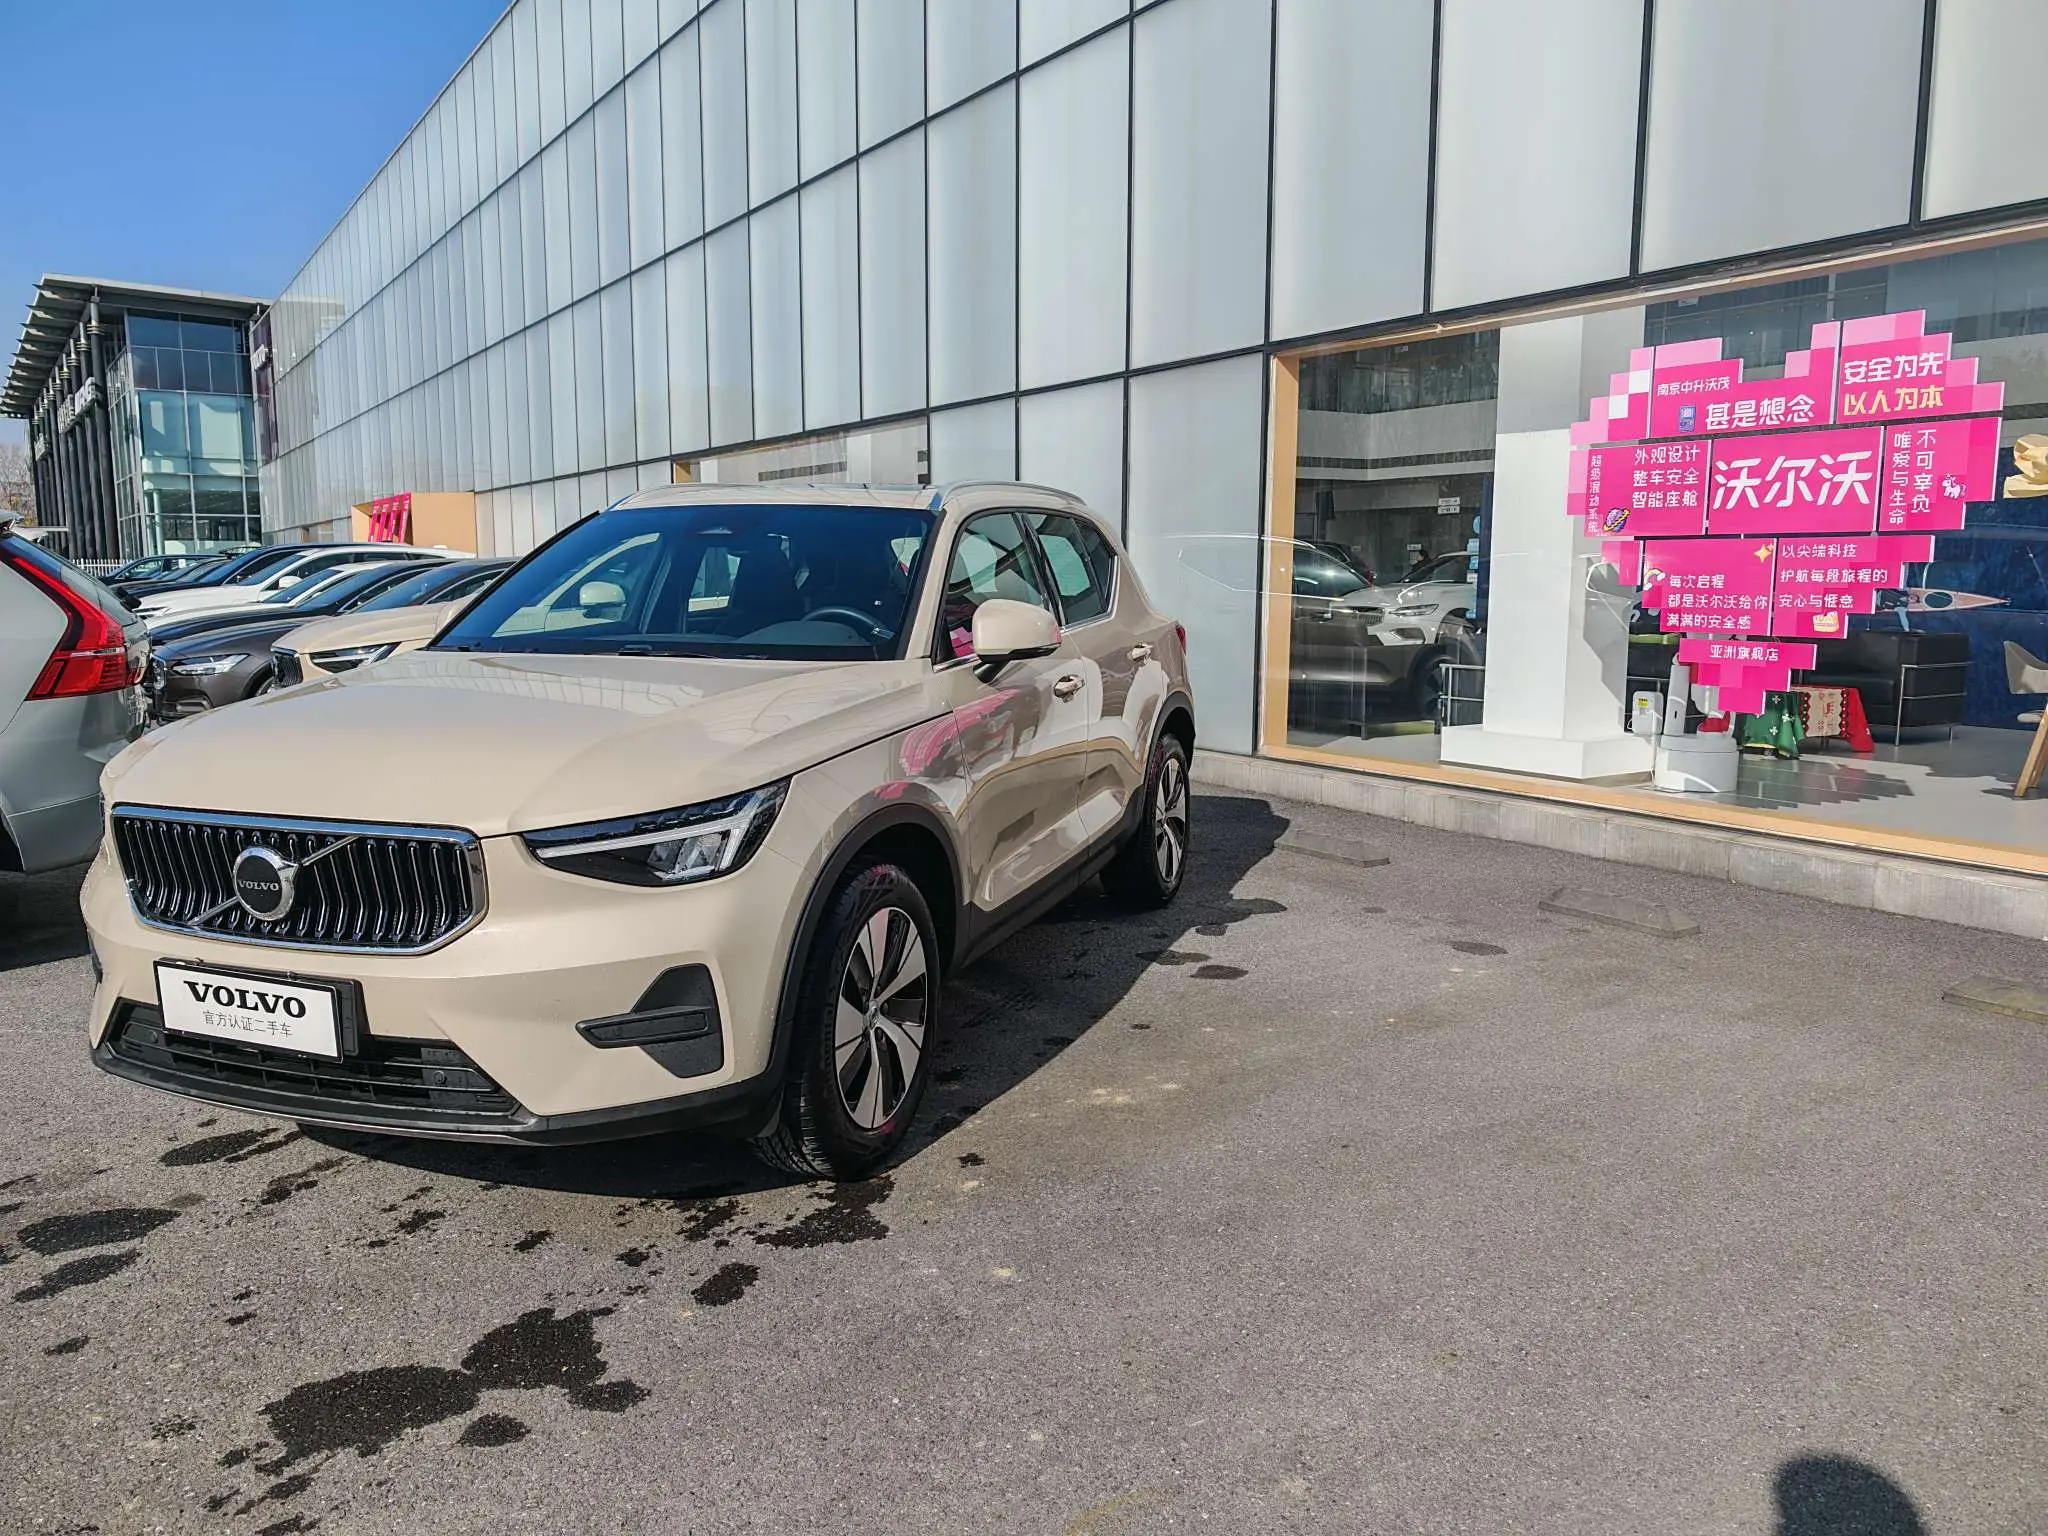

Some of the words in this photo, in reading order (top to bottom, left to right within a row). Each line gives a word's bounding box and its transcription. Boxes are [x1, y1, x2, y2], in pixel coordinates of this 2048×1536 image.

[1844, 352, 1944, 384] 安全为先
[1656, 376, 1731, 397] 南京中升沃茂
[1843, 385, 1944, 416] 以人为本
[1705, 394, 1815, 431] 甚是想念
[1634, 445, 1701, 465] 外观设计
[1633, 467, 1700, 487] 整车安全
[1713, 451, 1873, 510] 沃尔沃
[1888, 431, 1912, 525] 唯爱与生命
[1632, 489, 1698, 509] 智能座舱
[1782, 544, 1858, 559] 以尖端科技
[1669, 574, 1726, 589] 每次启程
[1780, 568, 1889, 584] 护航每段旅程的
[1667, 593, 1769, 610] 都是沃尔沃给你
[1666, 612, 1752, 630] 满满的安全感
[1709, 644, 1780, 662] 亚洲旗舰店
[236, 879, 280, 892] VOLVO
[183, 980, 307, 1019] VOLVO
[202, 1010, 293, 1038] 官方认证二手车
